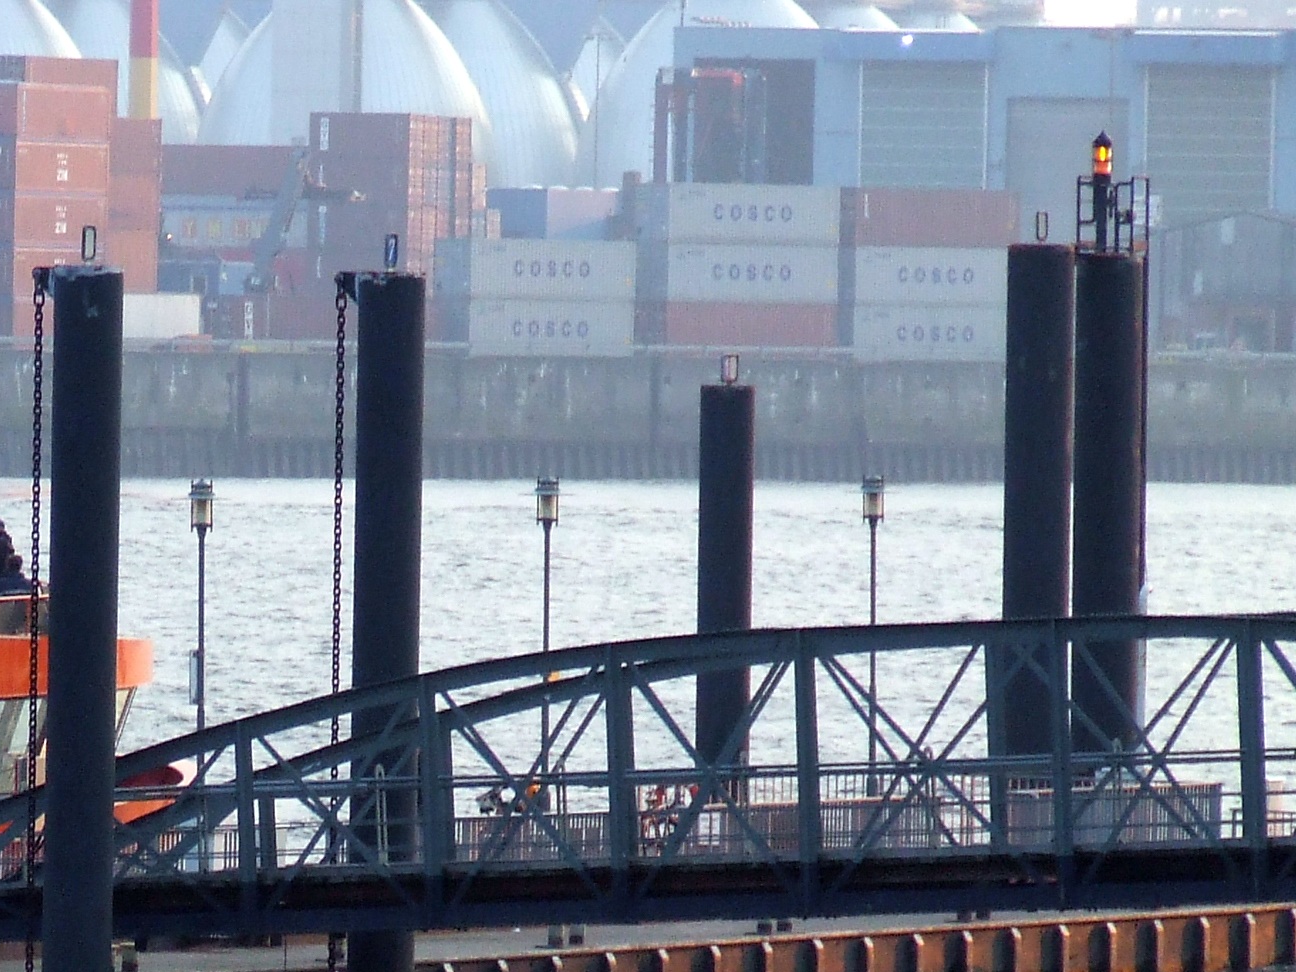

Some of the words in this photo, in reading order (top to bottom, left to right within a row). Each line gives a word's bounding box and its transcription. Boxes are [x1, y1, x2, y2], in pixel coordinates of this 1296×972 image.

[713, 203, 793, 222] COSCO
[514, 260, 590, 278] COSCO
[712, 263, 792, 281] COSCO
[898, 265, 974, 284] COSCO
[513, 320, 589, 339] COSCO
[896, 325, 974, 342] COSCO
